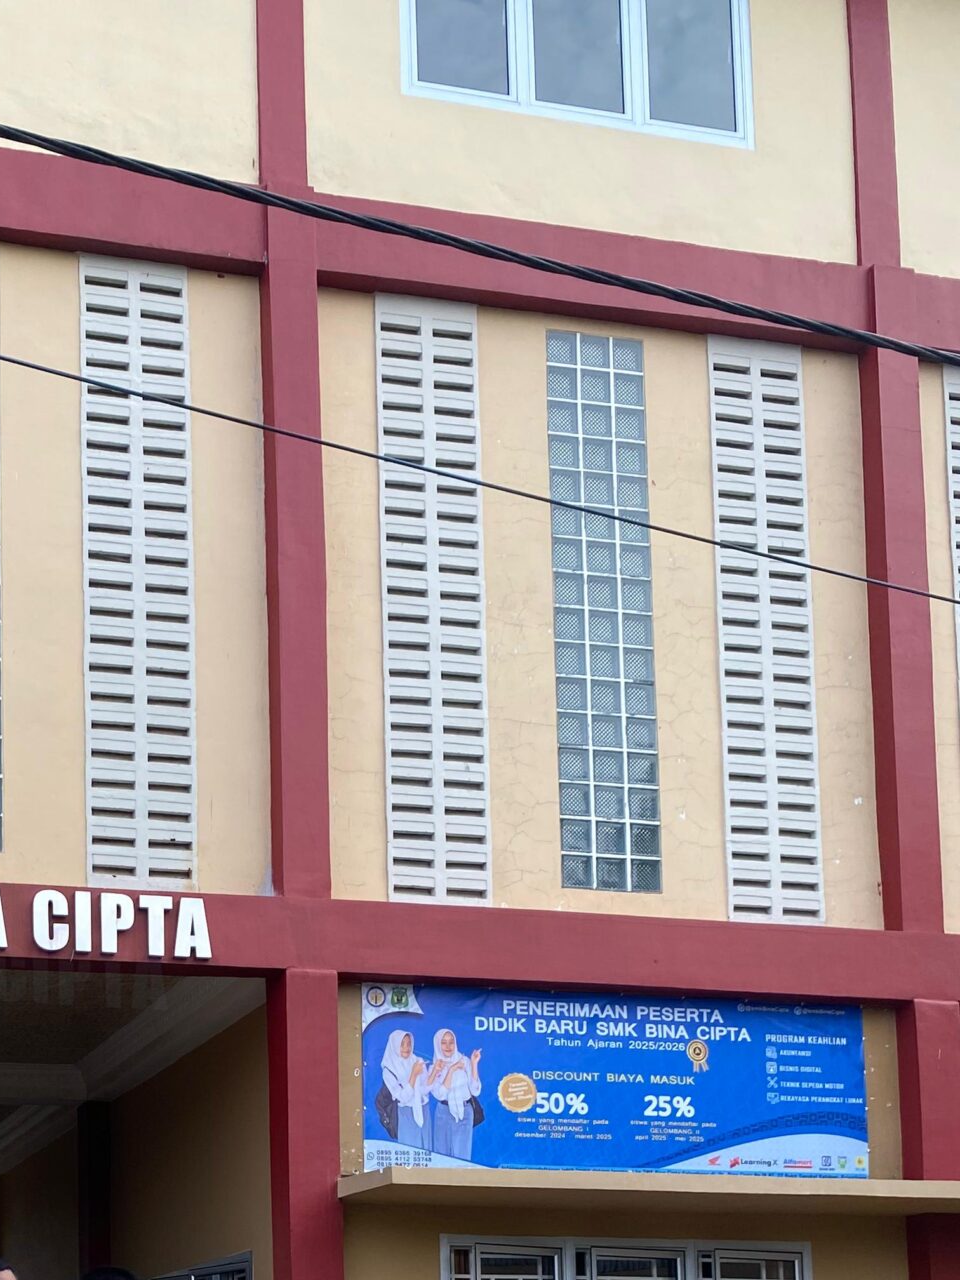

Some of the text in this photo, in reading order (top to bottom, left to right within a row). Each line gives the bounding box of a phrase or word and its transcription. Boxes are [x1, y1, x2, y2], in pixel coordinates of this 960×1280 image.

[32, 888, 213, 960] CIPTA
[502, 999, 628, 1019] PENERIMAAN
[637, 1006, 724, 1024] PESERTA
[474, 1016, 752, 1042] DIDIK BARU SMK BINA CIPTA
[546, 1037, 686, 1051] Tahun Ajaran 2025/2026
[765, 1034, 847, 1045] PROGRAM KEAHLIAN
[532, 1070, 696, 1086] DISCOUNT BIAYA MASUK
[535, 1092, 589, 1116] 50%
[643, 1094, 696, 1118] 25%
[649, 1127, 693, 1135] GELOMBANG
[740, 1158, 772, 1168] Learning
